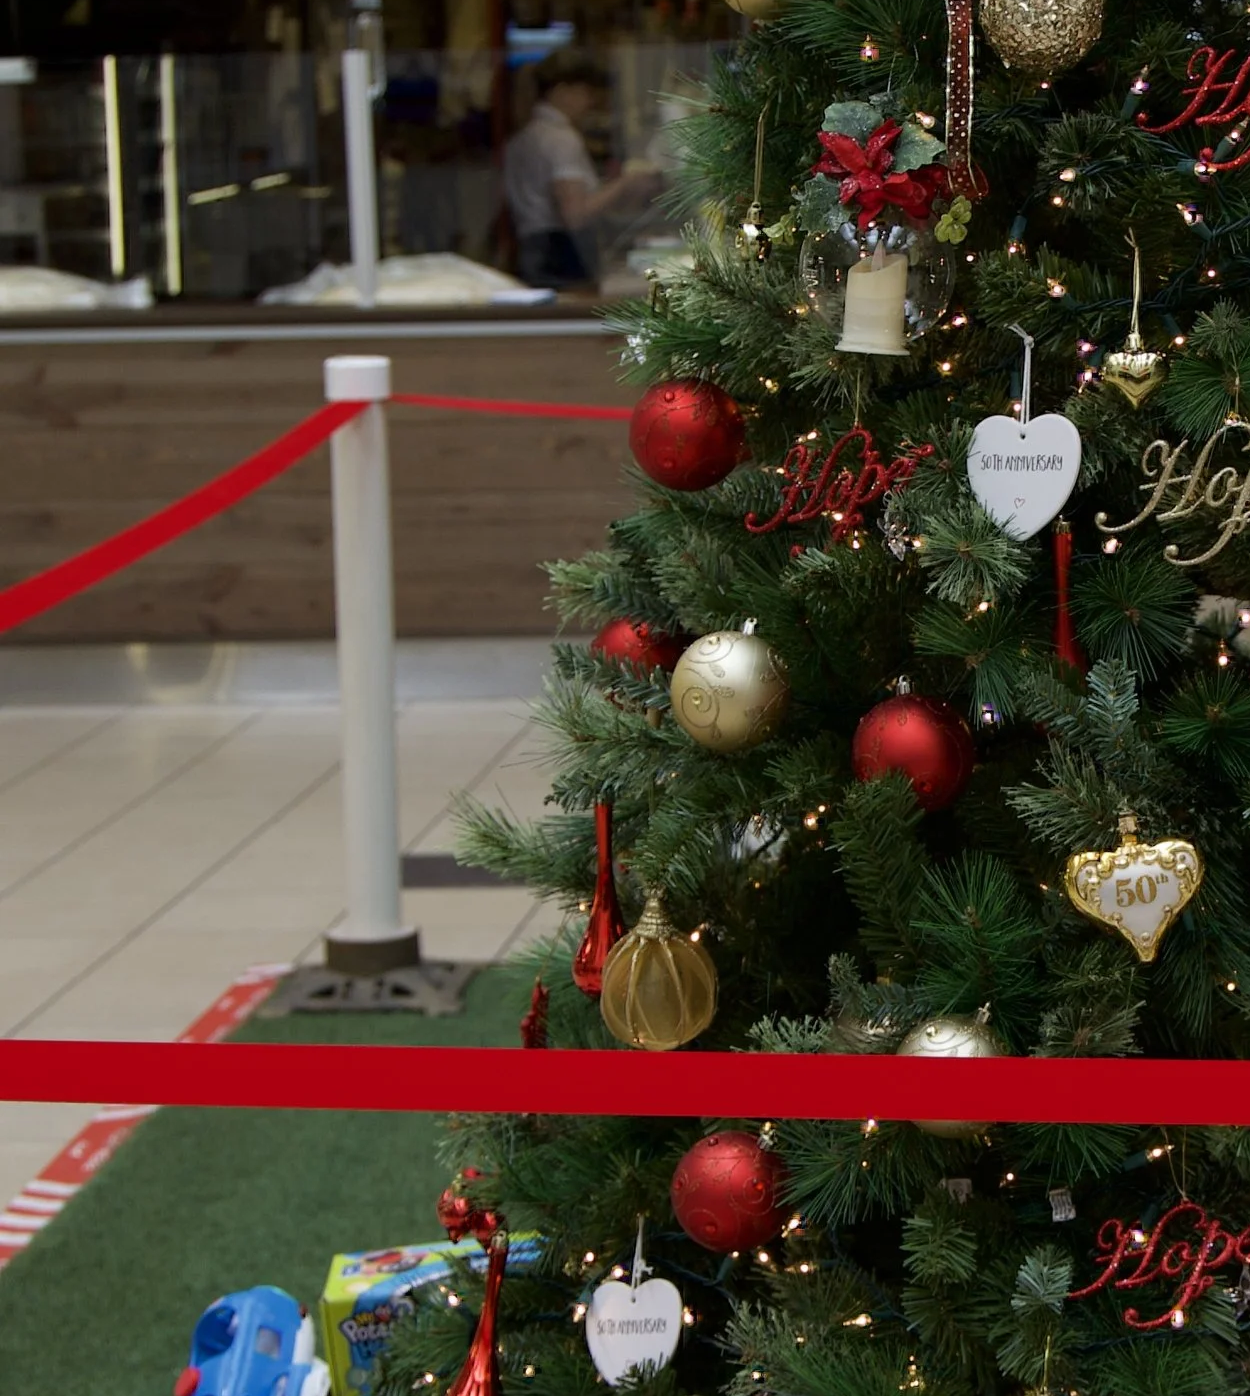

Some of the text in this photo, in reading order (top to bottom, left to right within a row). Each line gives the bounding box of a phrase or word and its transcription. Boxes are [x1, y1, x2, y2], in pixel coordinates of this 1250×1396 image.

[980, 453, 1063, 472] 50TH ANNIVERSARY
[744, 426, 936, 557] Hope
[1115, 873, 1169, 908] 50th
